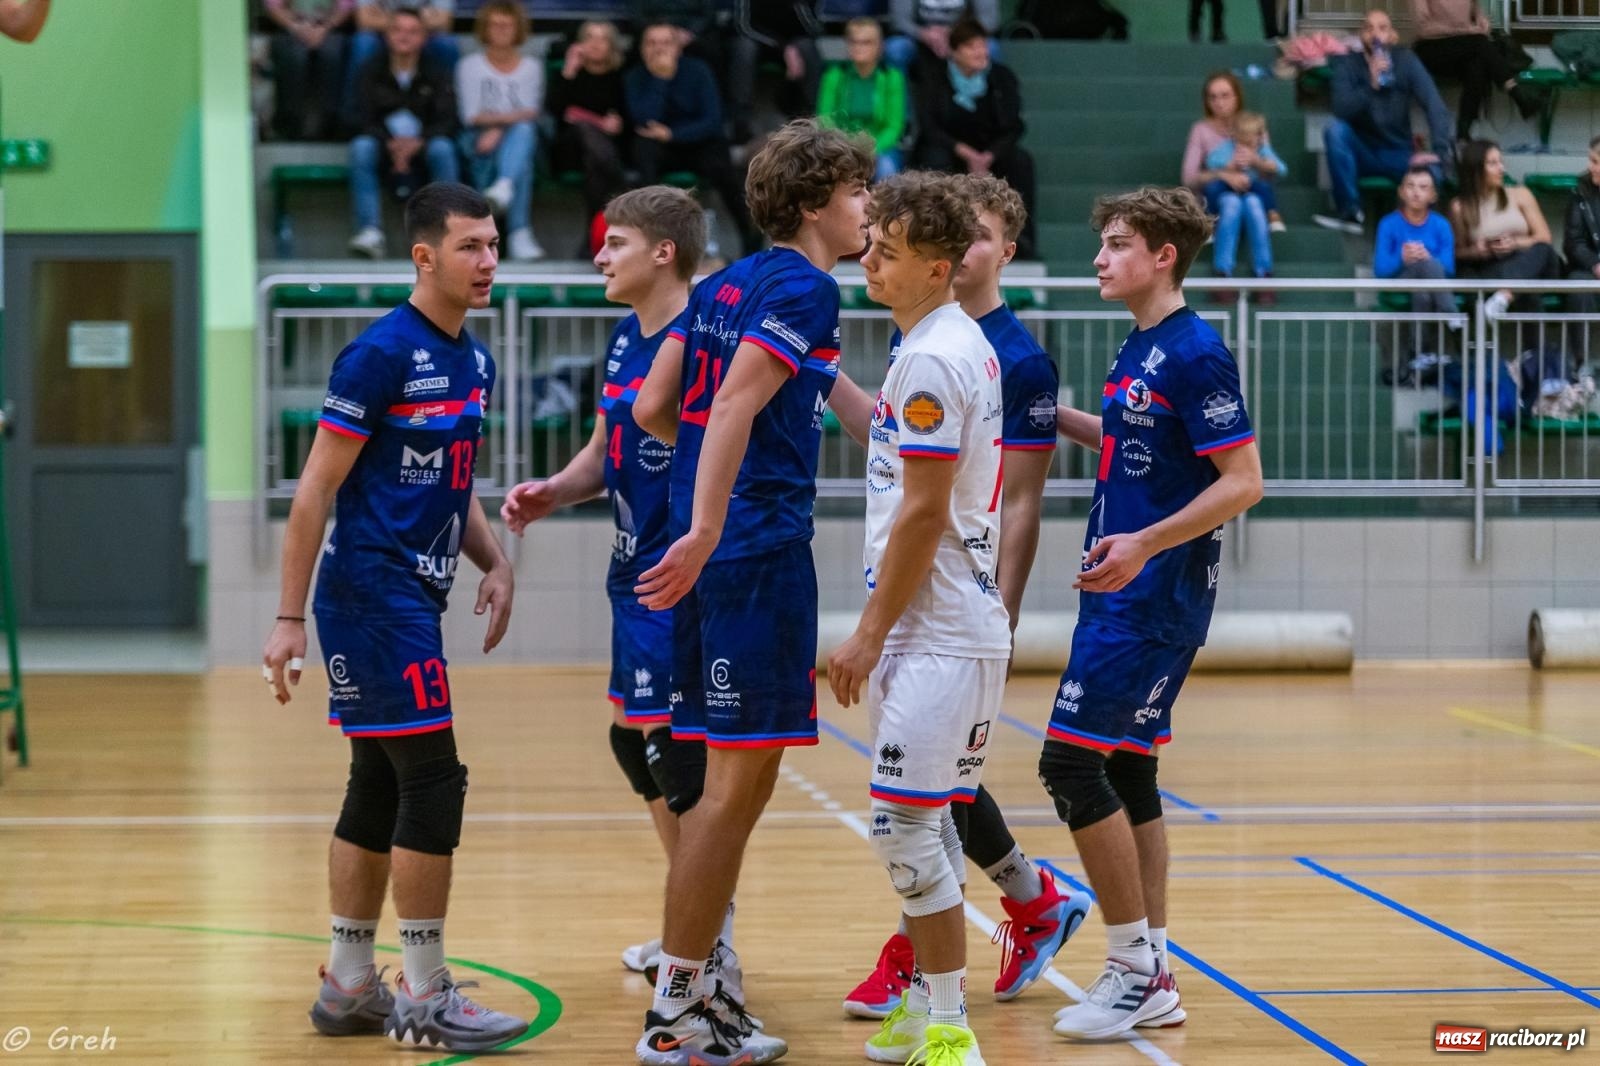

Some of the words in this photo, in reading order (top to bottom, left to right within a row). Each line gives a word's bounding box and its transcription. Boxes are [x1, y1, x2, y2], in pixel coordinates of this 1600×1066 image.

[608, 424, 623, 470] 4
[449, 440, 473, 489] 13
[400, 468, 441, 479] HOTELS
[403, 658, 450, 710] 13
[706, 691, 741, 699] CYBER
[706, 699, 741, 707] GROTA
[1056, 698, 1079, 713] errea
[877, 763, 903, 778] errea
[872, 827, 891, 836] errea
[333, 925, 375, 939] MKS
[399, 928, 440, 939] MKS
[668, 968, 693, 999] MKS
